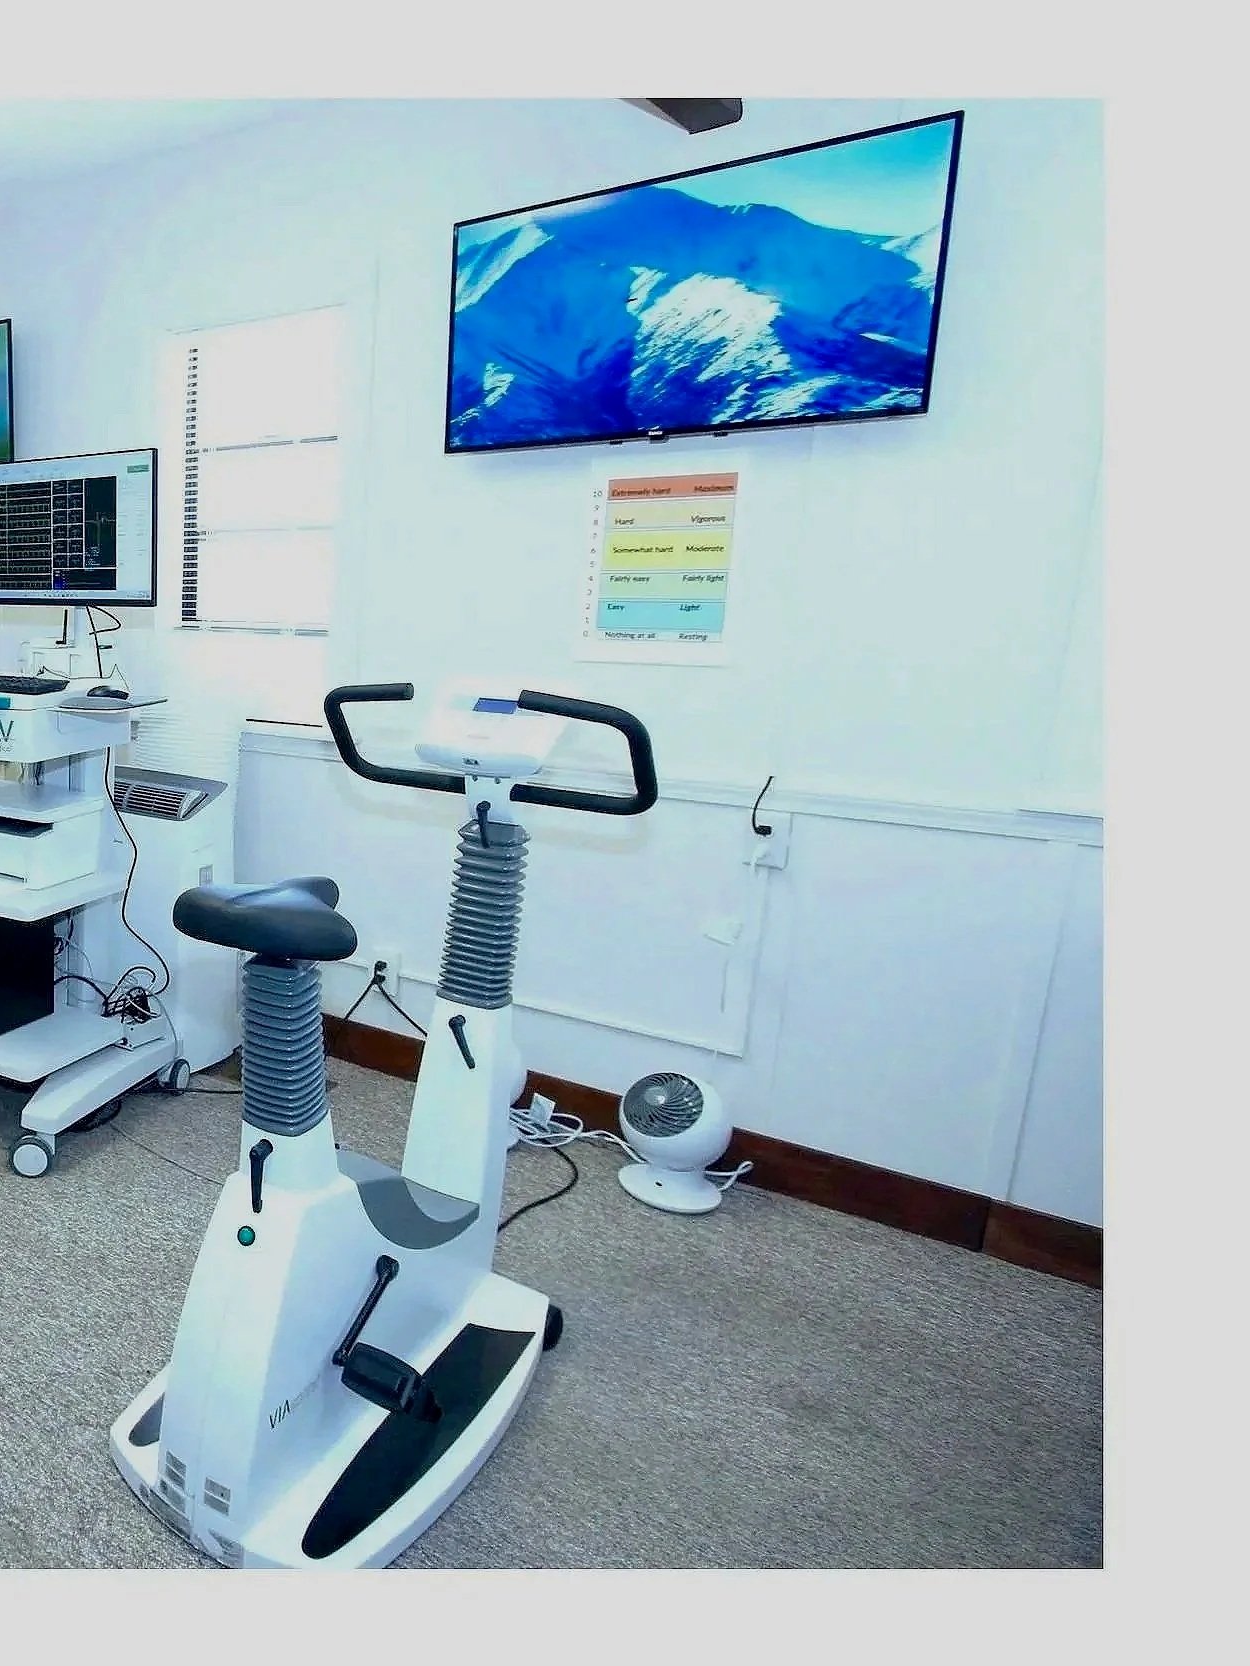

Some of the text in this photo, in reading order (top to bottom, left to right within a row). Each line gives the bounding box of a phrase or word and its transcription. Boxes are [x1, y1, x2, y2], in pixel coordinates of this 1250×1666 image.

[690, 515, 726, 524] Vigorous
[612, 546, 654, 554] Somewhat
[610, 575, 631, 584] Fairly
[682, 575, 725, 584] Fairly light
[679, 603, 701, 612] Light
[605, 631, 635, 640] Nothing
[678, 633, 708, 641] Resting
[269, 1399, 291, 1429] VIA
